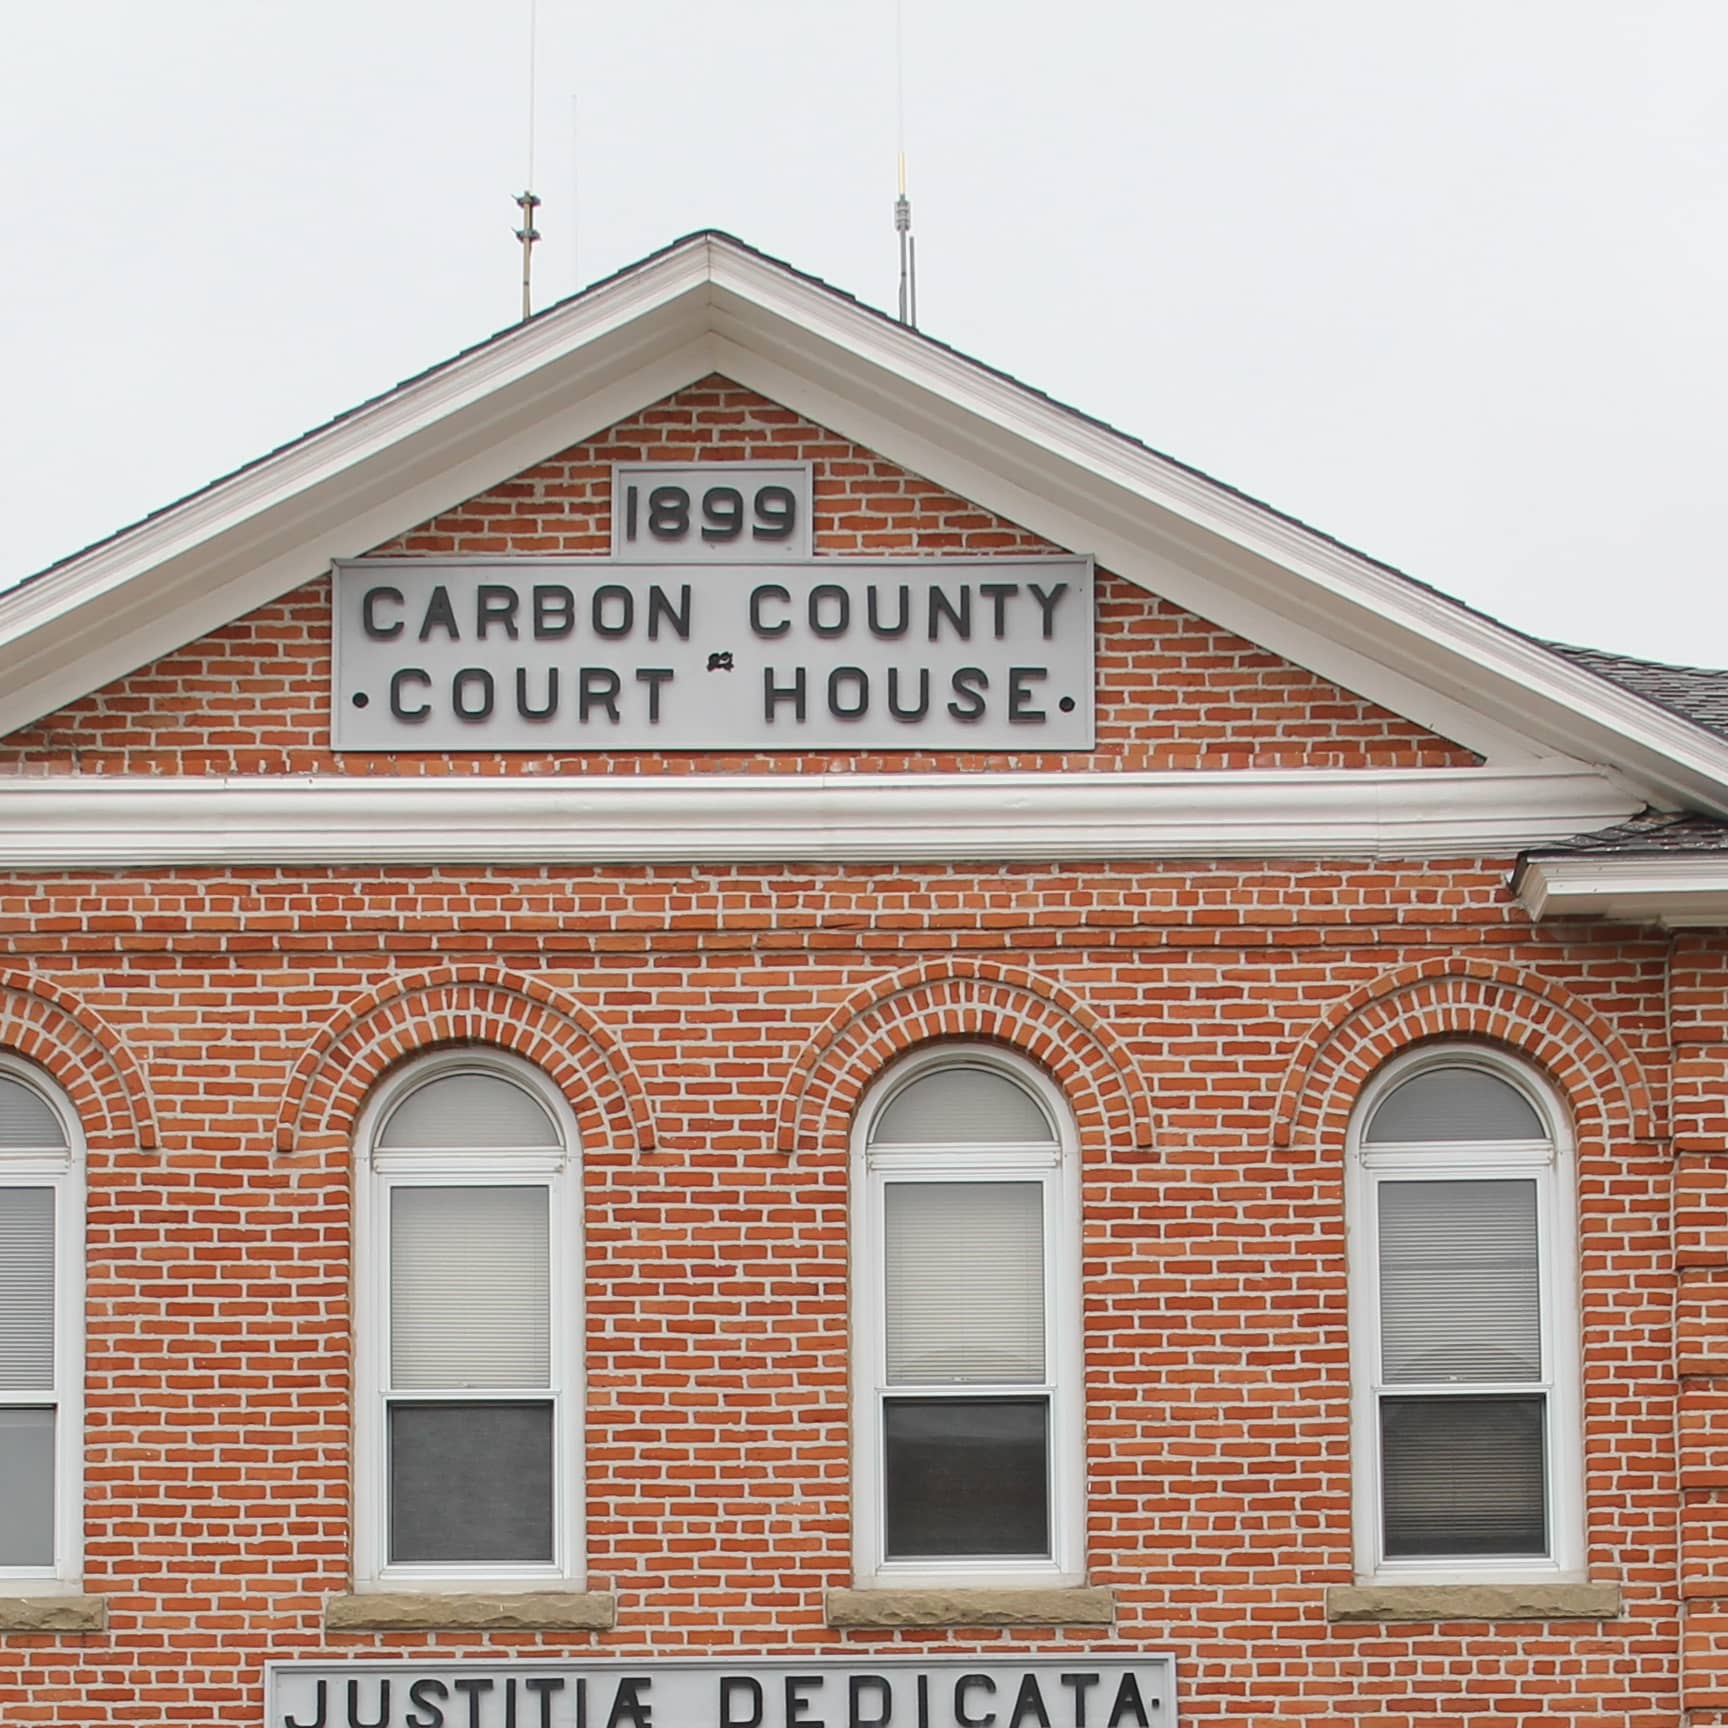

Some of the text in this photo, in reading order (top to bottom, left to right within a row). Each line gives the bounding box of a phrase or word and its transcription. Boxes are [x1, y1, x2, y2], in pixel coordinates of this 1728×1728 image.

[626, 485, 797, 542] 1899
[362, 582, 1069, 641] CARBON COUNTY
